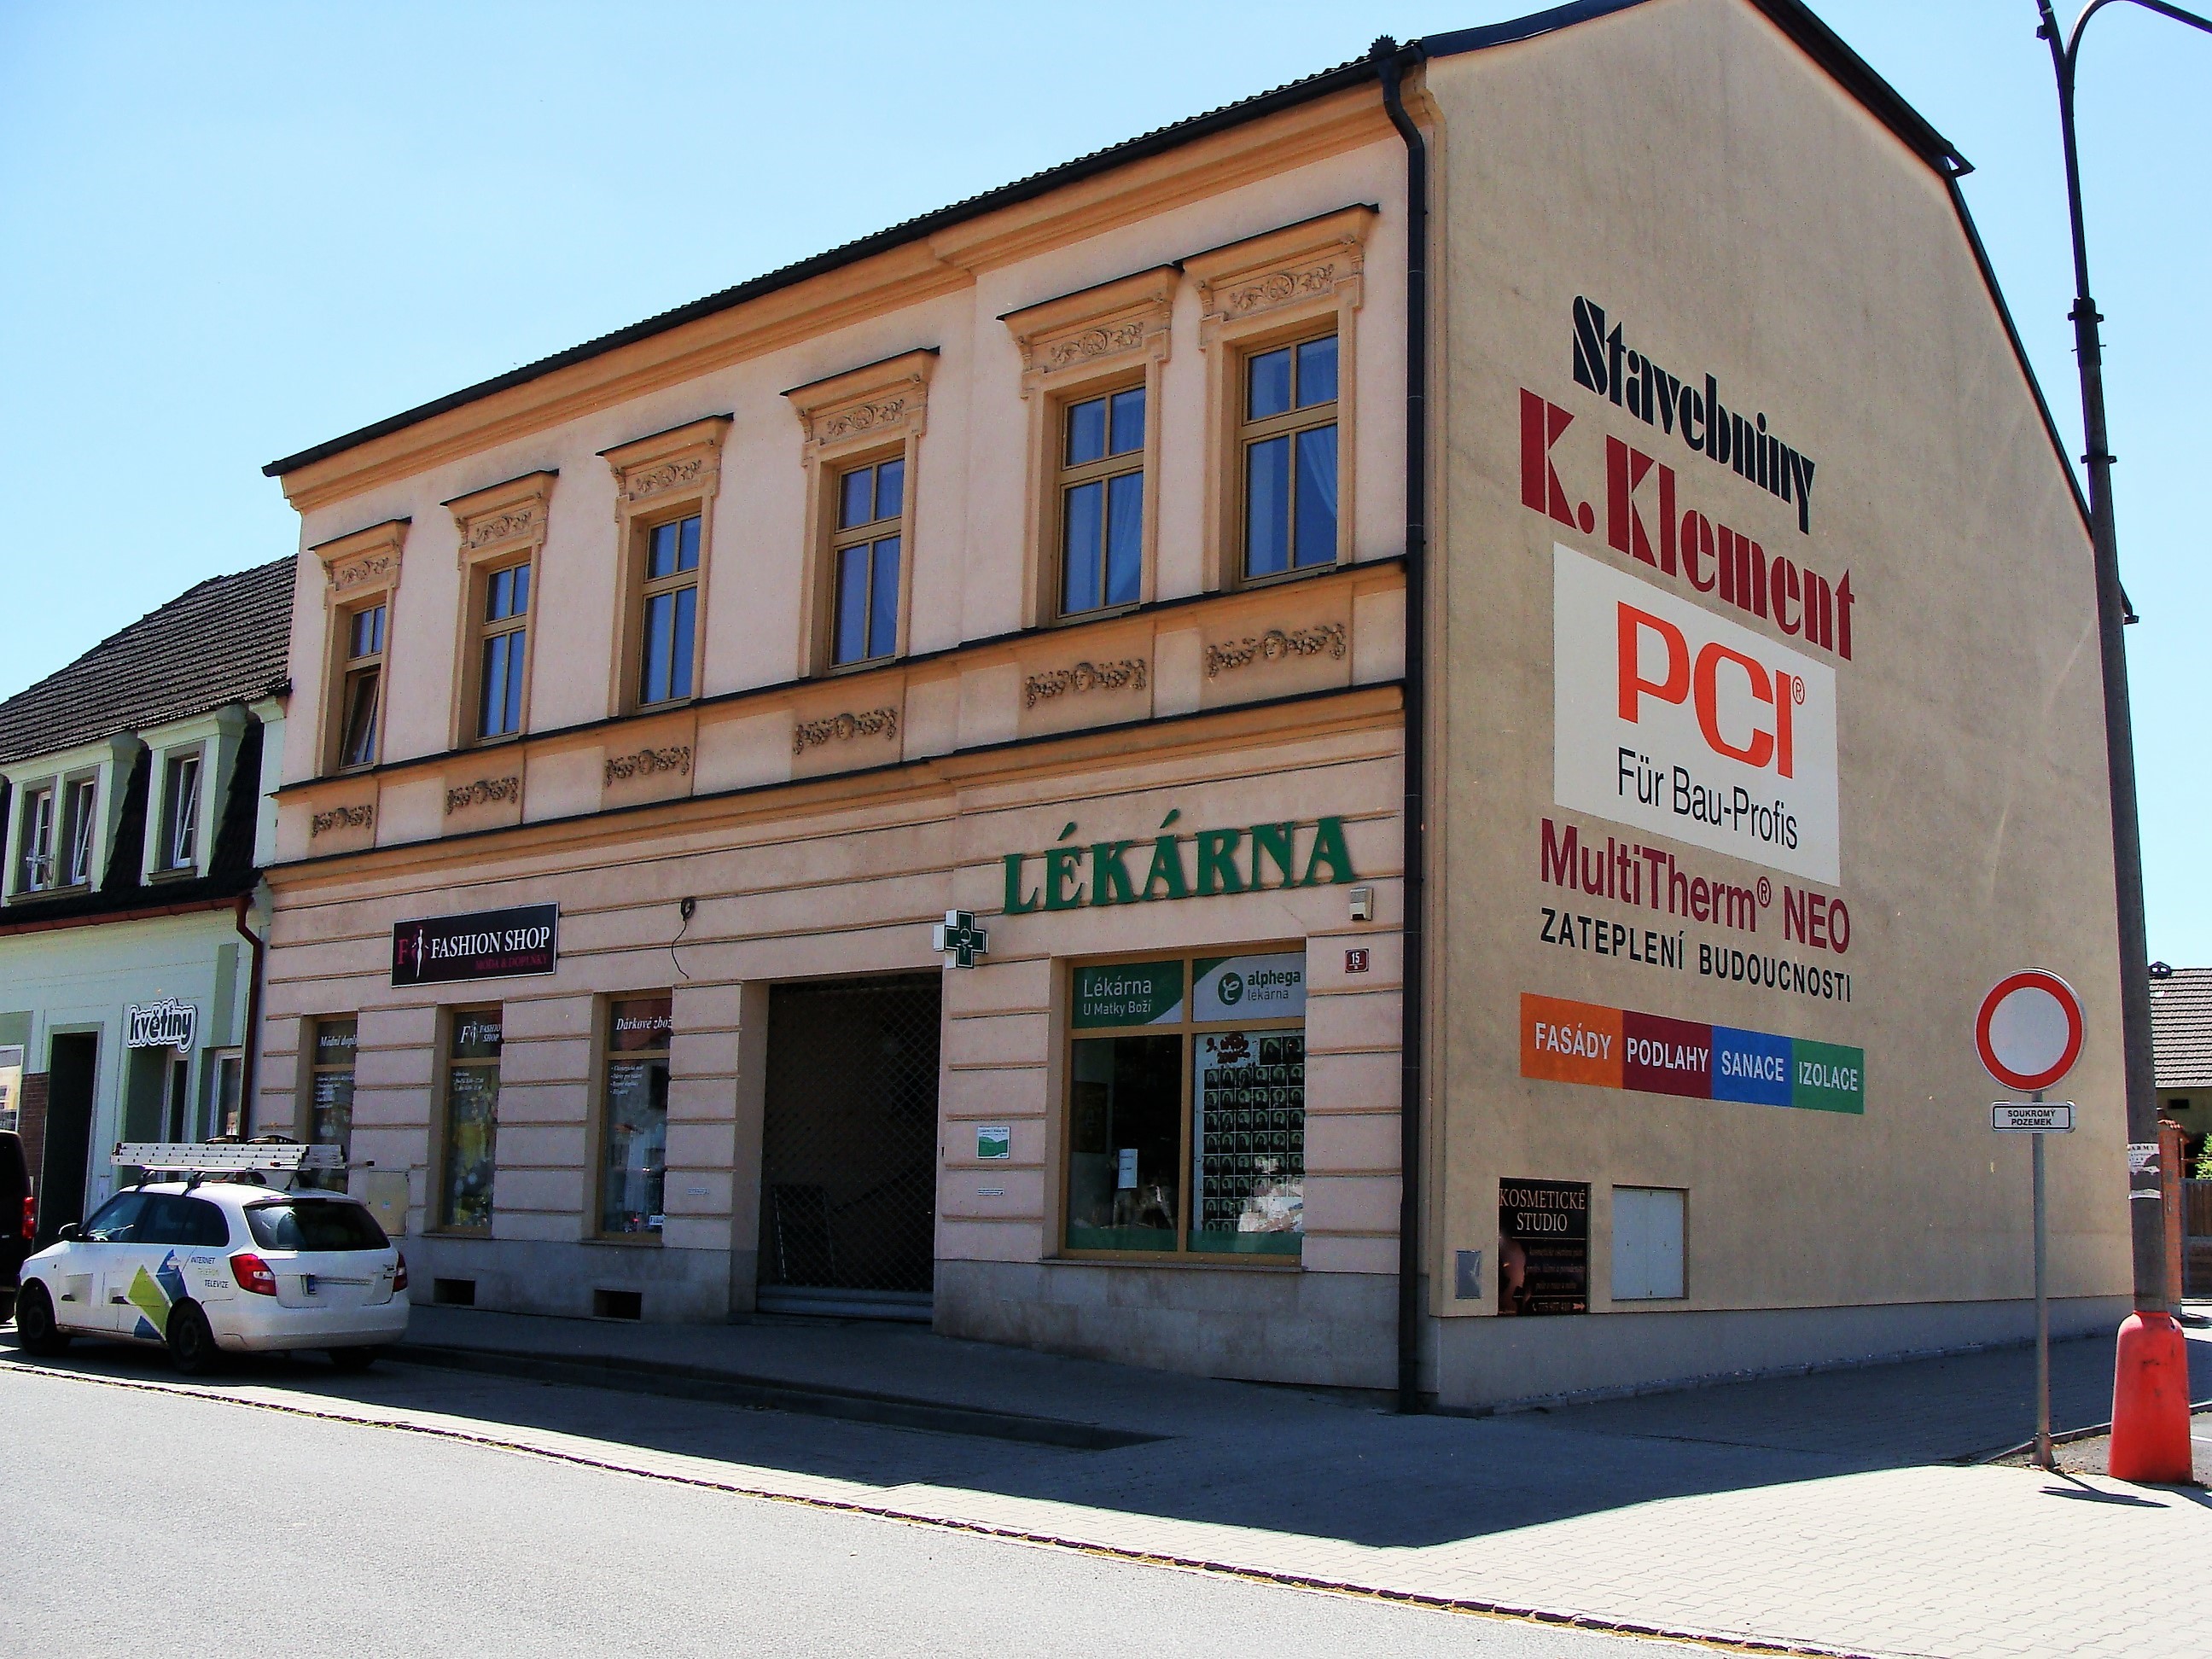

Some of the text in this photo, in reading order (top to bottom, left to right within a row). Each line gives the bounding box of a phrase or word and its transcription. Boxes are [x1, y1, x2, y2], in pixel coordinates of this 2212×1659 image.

[1572, 295, 1815, 535] Stavebniny
[1520, 387, 1855, 661] K. Klement
[1618, 747, 1797, 850] Für Bau-Profis
[1003, 808, 1358, 915] LÉKÁRNA
[1784, 885, 1851, 954] NEO
[430, 931, 502, 959] FASHION
[504, 926, 550, 952] SHOP
[1351, 952, 1360, 964] 15
[1540, 907, 1851, 1003] ZATEPLENÍ BUDOUCNOSTI
[1083, 975, 1152, 998] Lékárna
[1247, 969, 1301, 987] alphega
[1247, 987, 1289, 1001] lékárna
[1083, 999, 1152, 1017] U Matky Boží
[128, 1003, 194, 1047] květiny
[615, 1016, 652, 1030] Dárkové
[1534, 1022, 1859, 1092] FASÁDY PODLAHY SANACE IZOLACE
[2011, 1118, 2052, 1126] POZEMEK
[1499, 1188, 1586, 1210] KOSMETICKÉ
[1516, 1212, 1569, 1231] STUDIO
[190, 1256, 216, 1265] INTERNET
[204, 1279, 230, 1289] TELEVIZE
